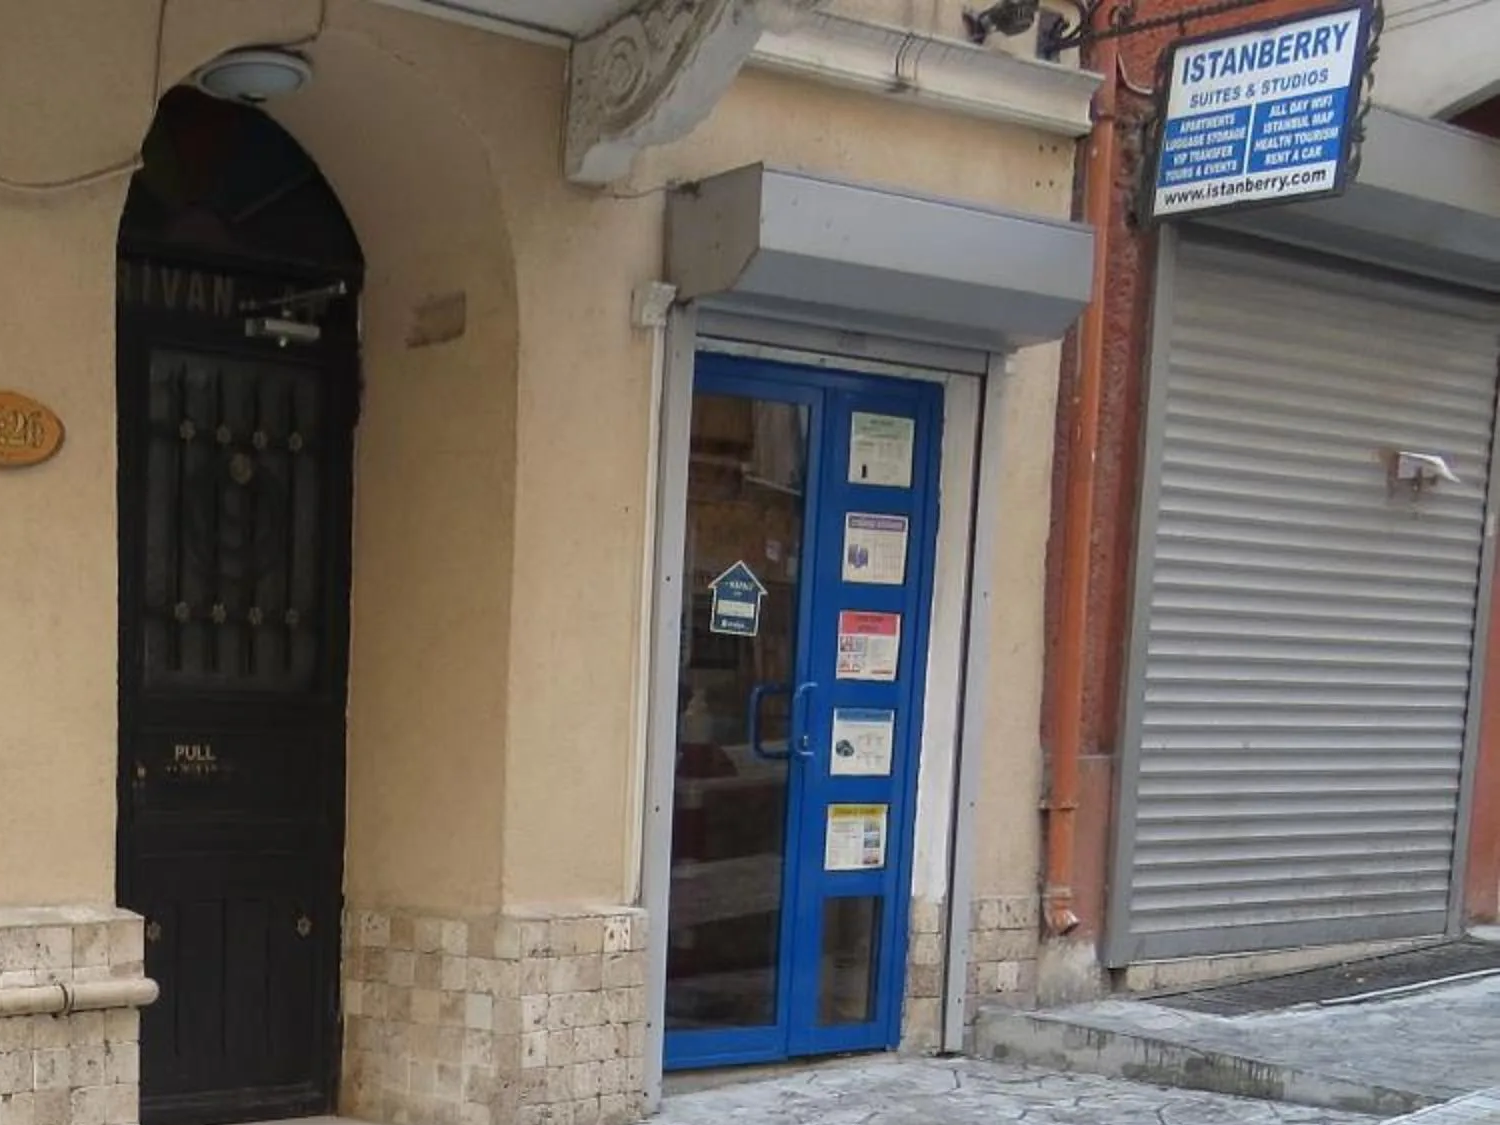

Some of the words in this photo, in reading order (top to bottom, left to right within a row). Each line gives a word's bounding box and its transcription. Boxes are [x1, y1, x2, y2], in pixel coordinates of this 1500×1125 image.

[1181, 21, 1351, 85] ISTANBERRY
[1189, 85, 1241, 108] SUITES
[1245, 82, 1256, 98] &
[1261, 68, 1329, 95] STUDIOS
[1268, 103, 1287, 118] ALL
[1289, 99, 1310, 115] DAY
[1263, 115, 1310, 134] ISTANBUL
[1311, 109, 1335, 126] MAP
[1253, 133, 1293, 152] HEALTH
[1264, 149, 1292, 166] RENT
[1291, 148, 1300, 162] A
[1301, 145, 1323, 160] CAR
[1164, 168, 1326, 205] www.istanberry.com
[174, 744, 217, 761] PULL
